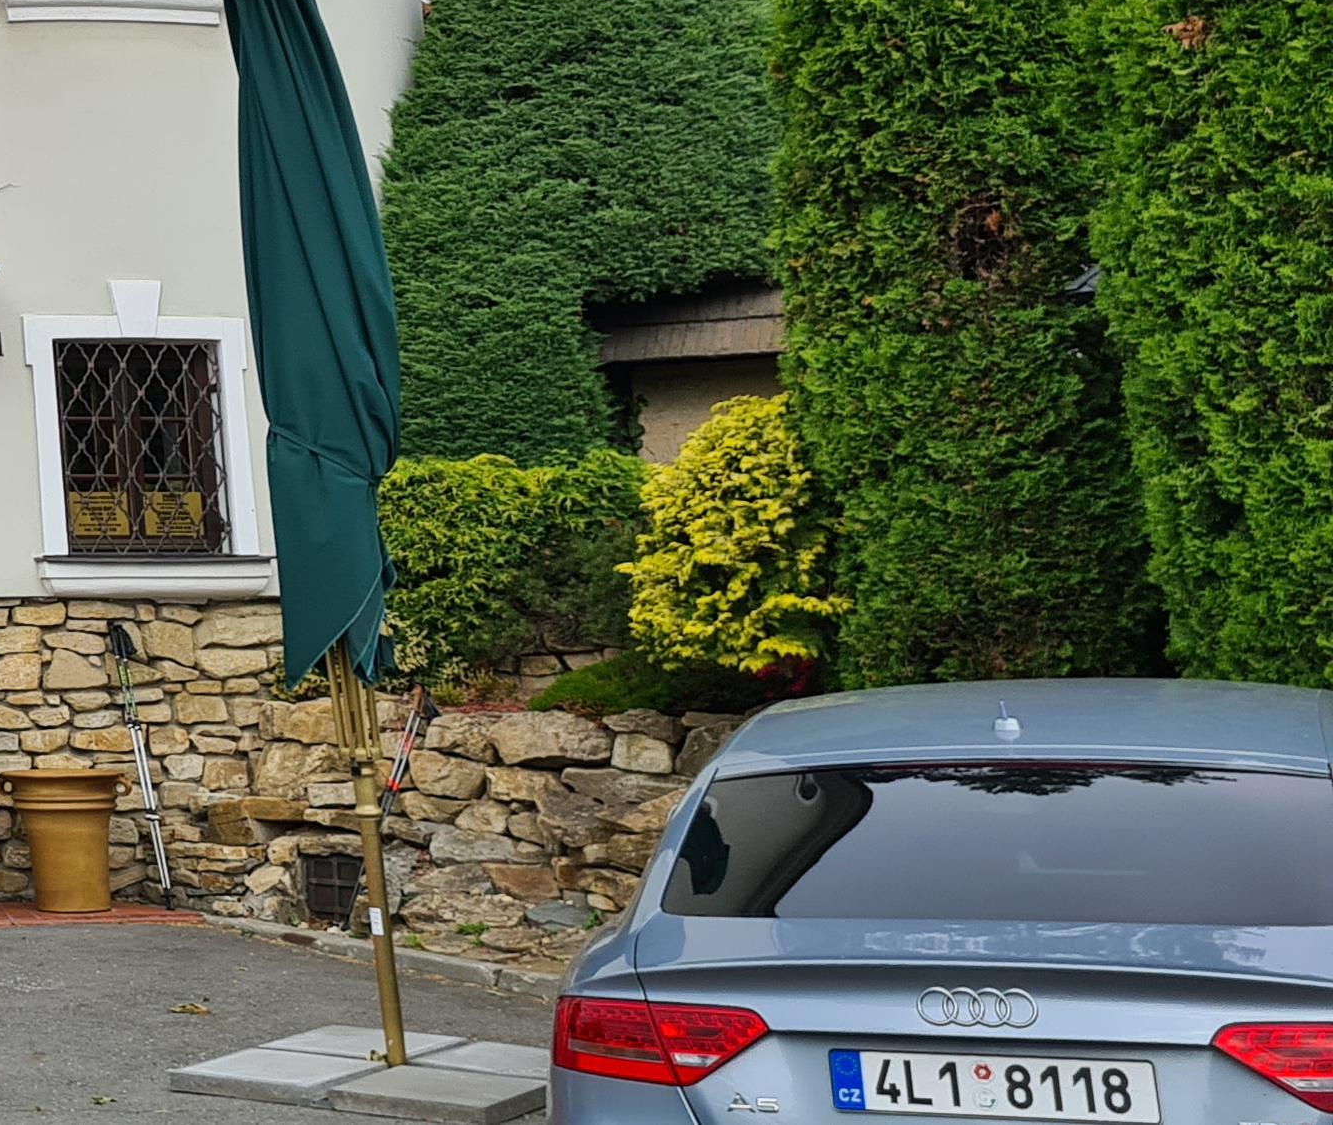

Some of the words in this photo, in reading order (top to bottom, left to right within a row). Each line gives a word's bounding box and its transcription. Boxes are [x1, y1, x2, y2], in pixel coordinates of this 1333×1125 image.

[727, 1091, 780, 1114] A5
[838, 1087, 861, 1103] CZ
[875, 1059, 961, 1107] 4L1
[1004, 1064, 1132, 1115] 8118
